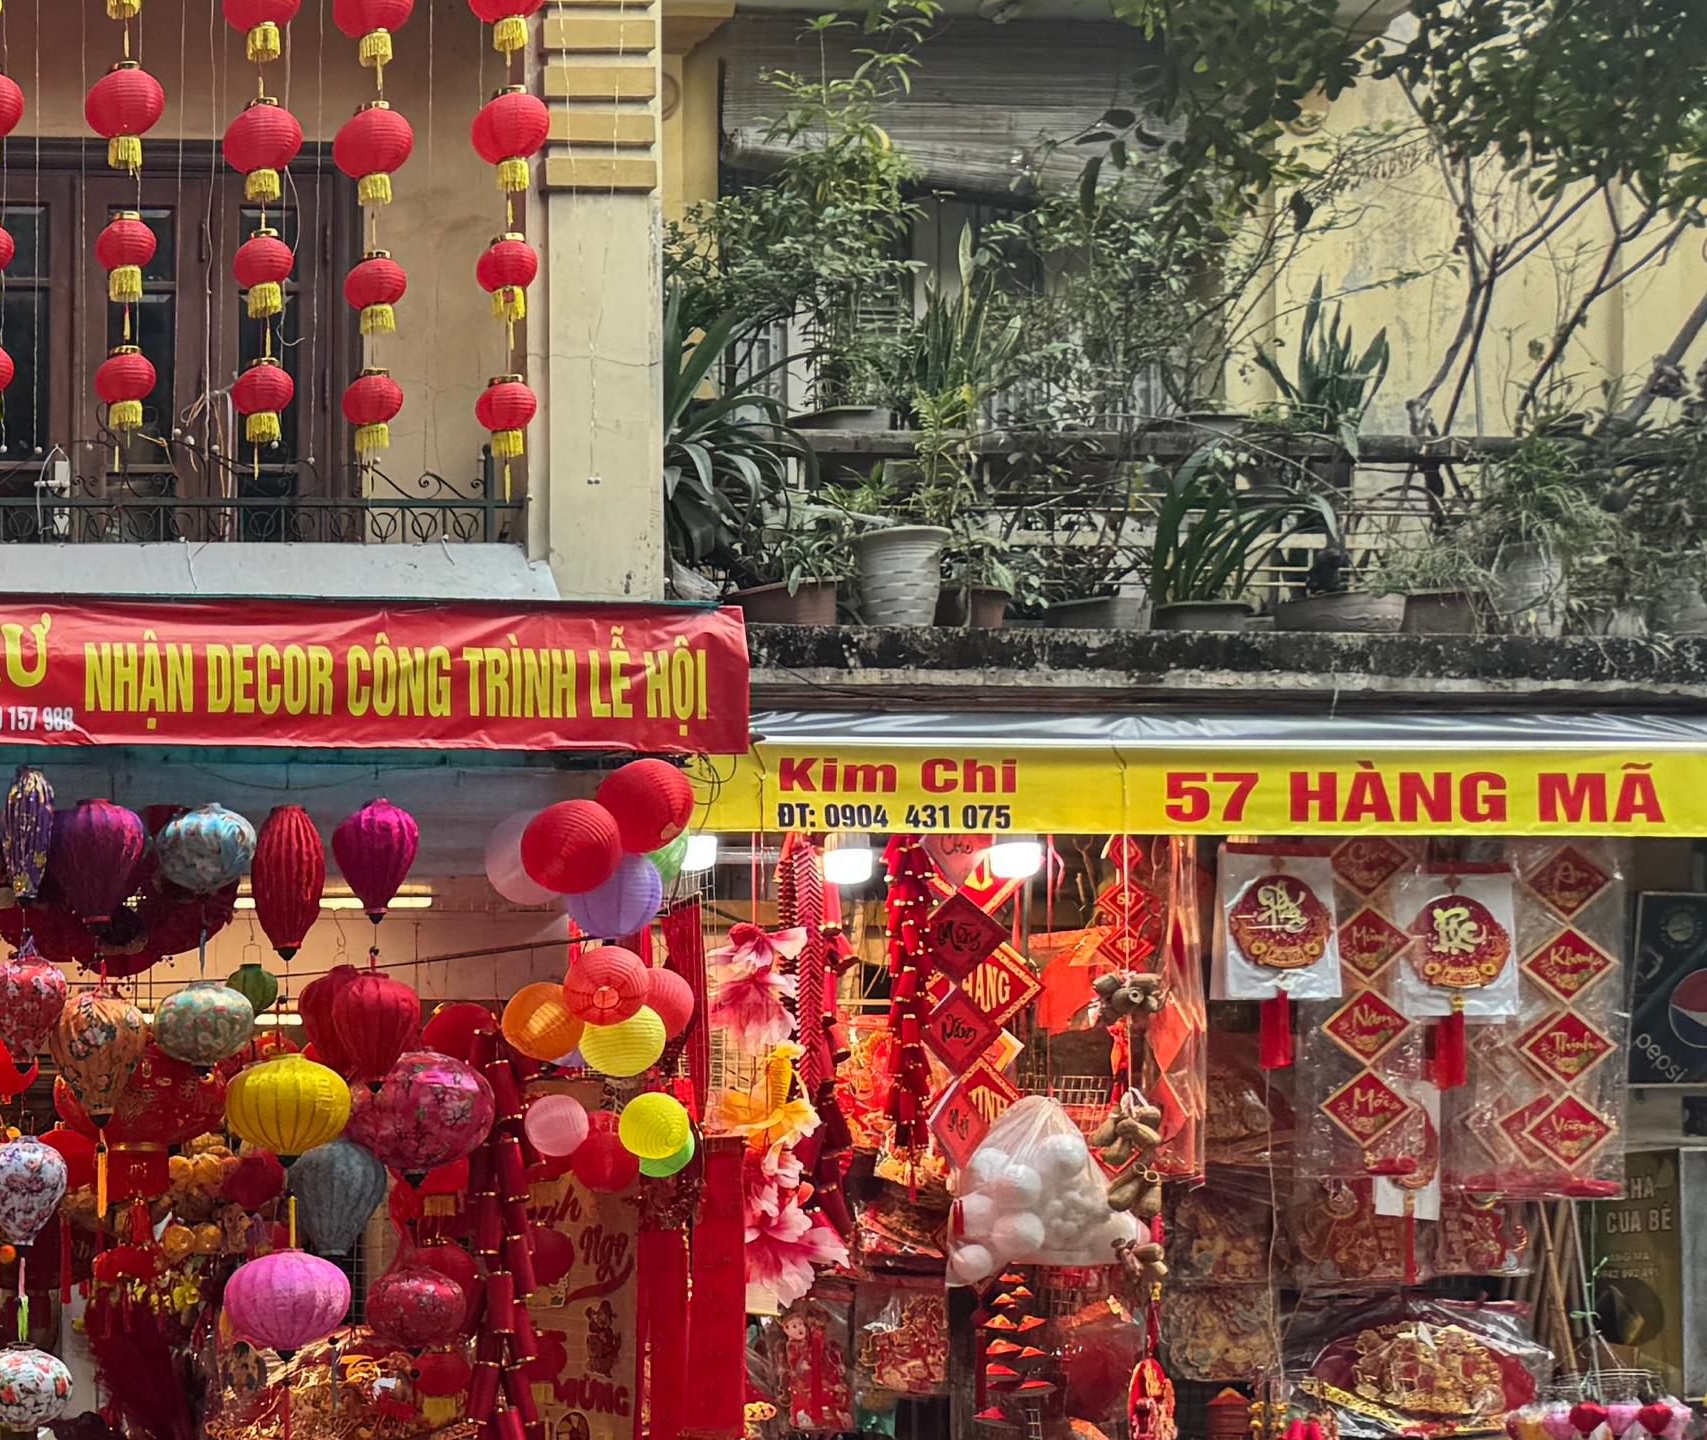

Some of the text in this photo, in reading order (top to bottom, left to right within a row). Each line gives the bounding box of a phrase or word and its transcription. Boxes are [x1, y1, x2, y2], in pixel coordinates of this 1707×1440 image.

[85, 626, 708, 737] NHẬN DECOR CÔNG TRÌNH LỄ HỘI
[8, 707, 39, 732] 157
[43, 708, 74, 733] 988
[778, 757, 1017, 793] Kim Chi
[1165, 759, 1666, 823] 57 HÀNG MÃ
[777, 803, 1011, 829] ĐT: 0904 431 075
[1630, 1032, 1688, 1084] pepsi
